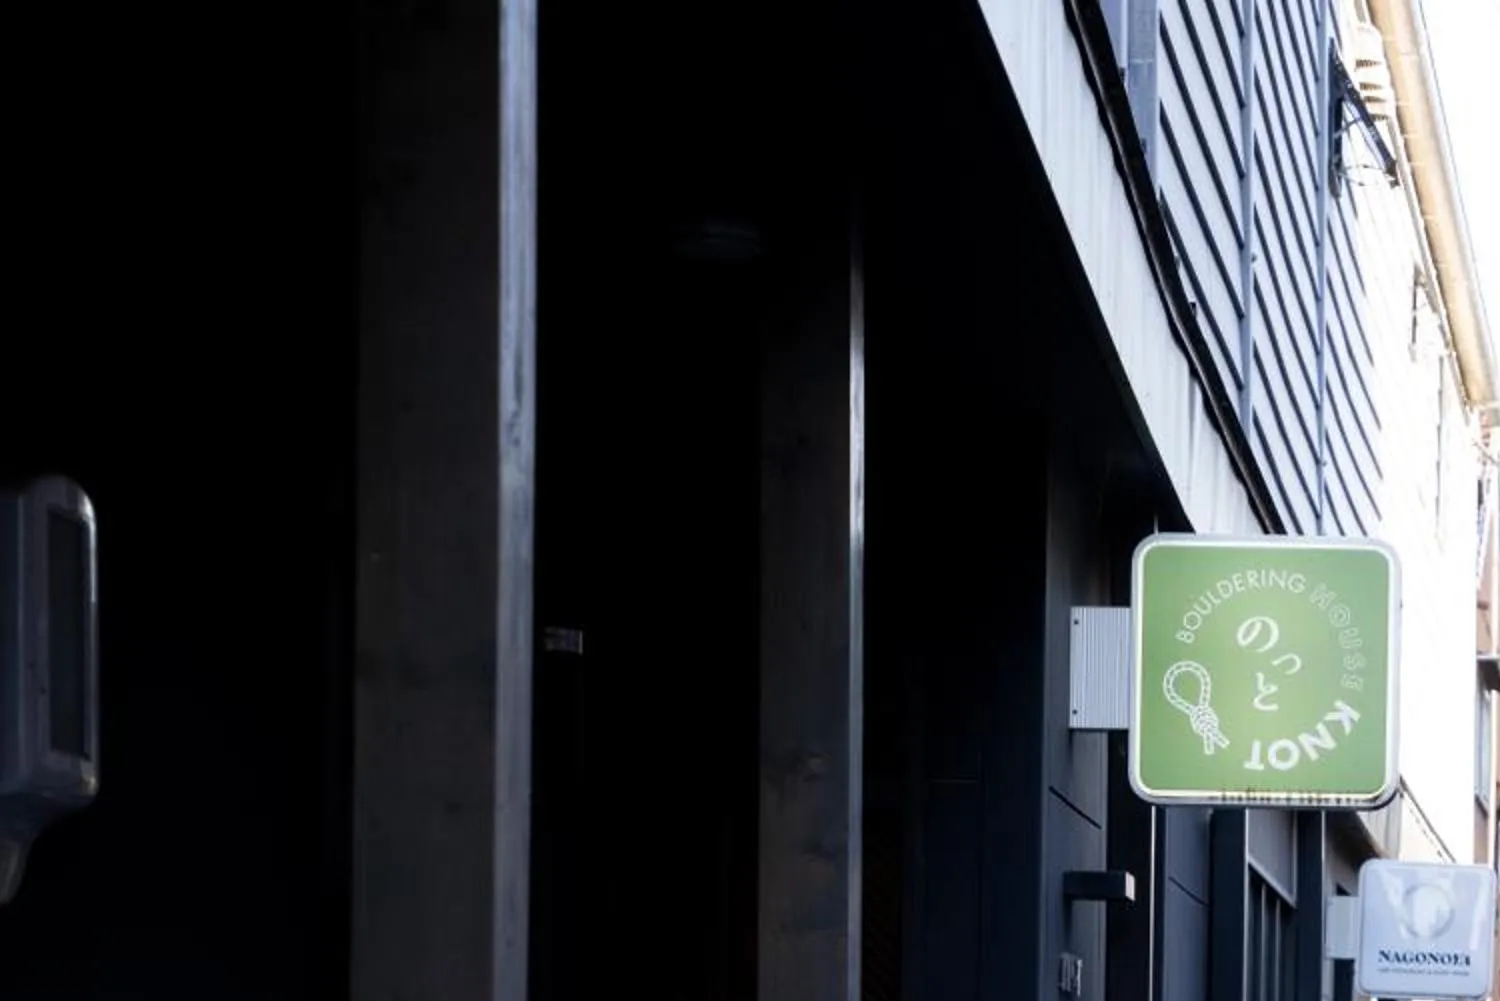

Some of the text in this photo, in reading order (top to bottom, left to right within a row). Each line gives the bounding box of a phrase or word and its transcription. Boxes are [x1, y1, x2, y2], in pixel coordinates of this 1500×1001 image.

[1175, 568, 1366, 693] BOULDERING HOUSE
[1236, 615, 1302, 711] のっと
[1243, 699, 1361, 771] KNOT
